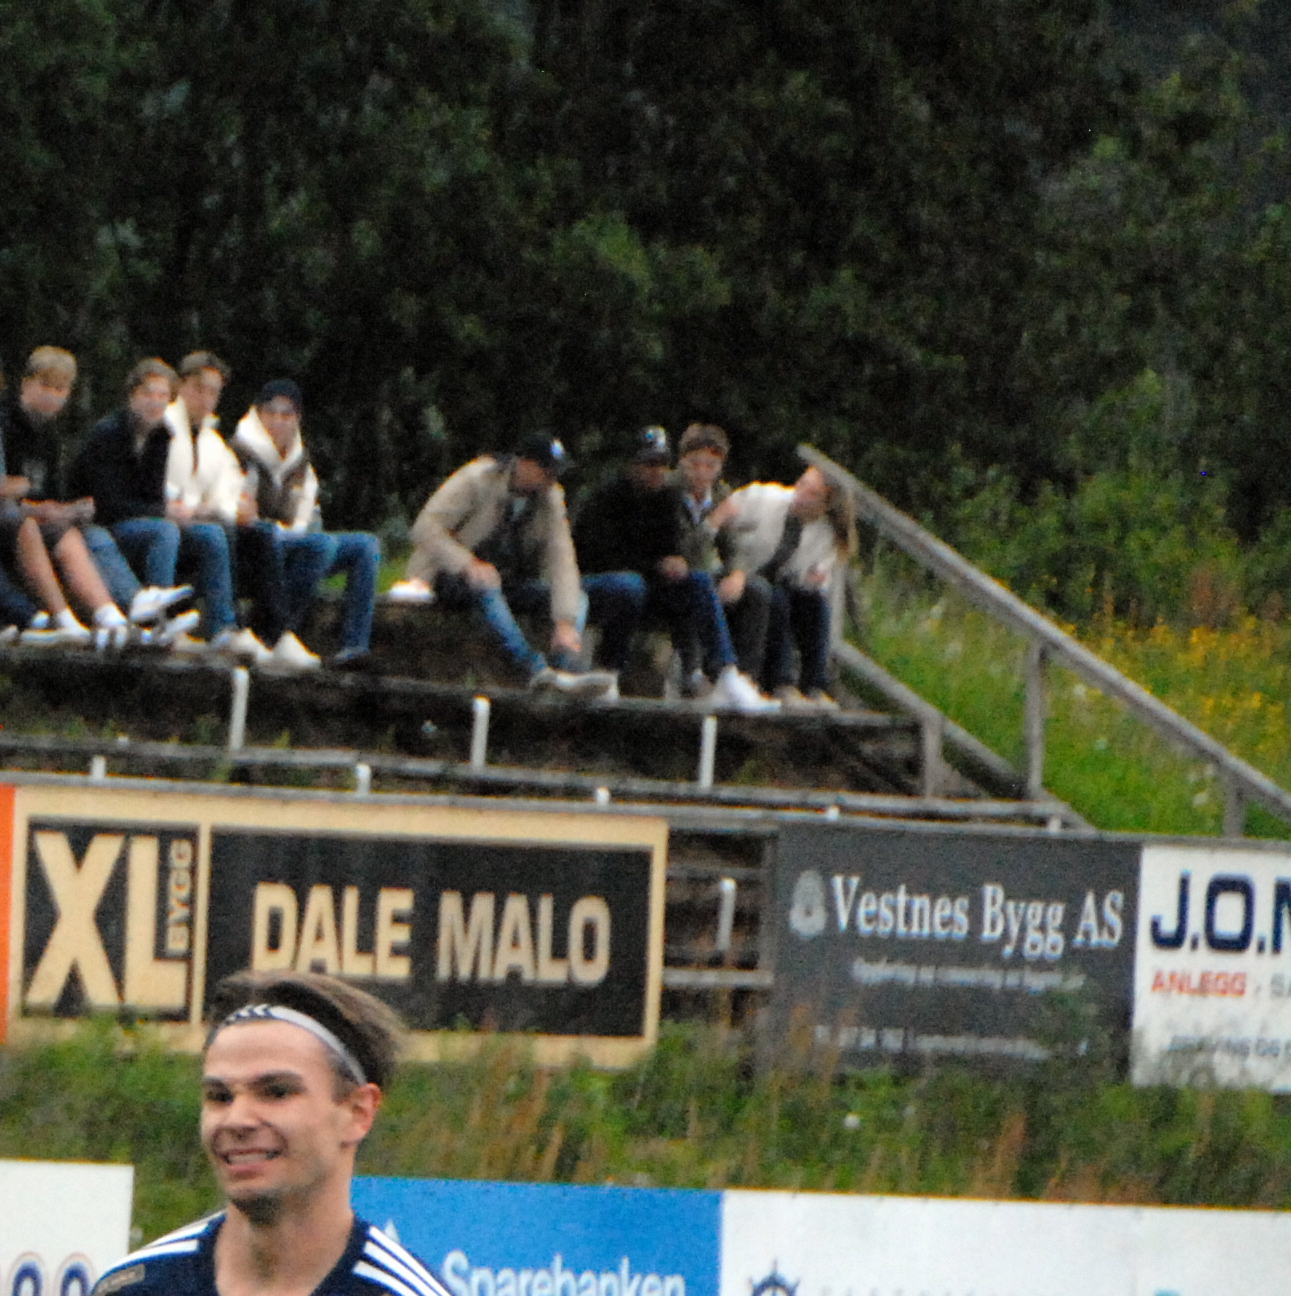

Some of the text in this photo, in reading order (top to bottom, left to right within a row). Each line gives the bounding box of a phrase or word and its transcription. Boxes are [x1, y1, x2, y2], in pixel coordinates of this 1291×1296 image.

[25, 831, 188, 1011] XL
[167, 838, 193, 955] BYGG
[252, 881, 610, 987] DALE MALO
[830, 874, 1124, 960] Vestnes Bygg AS
